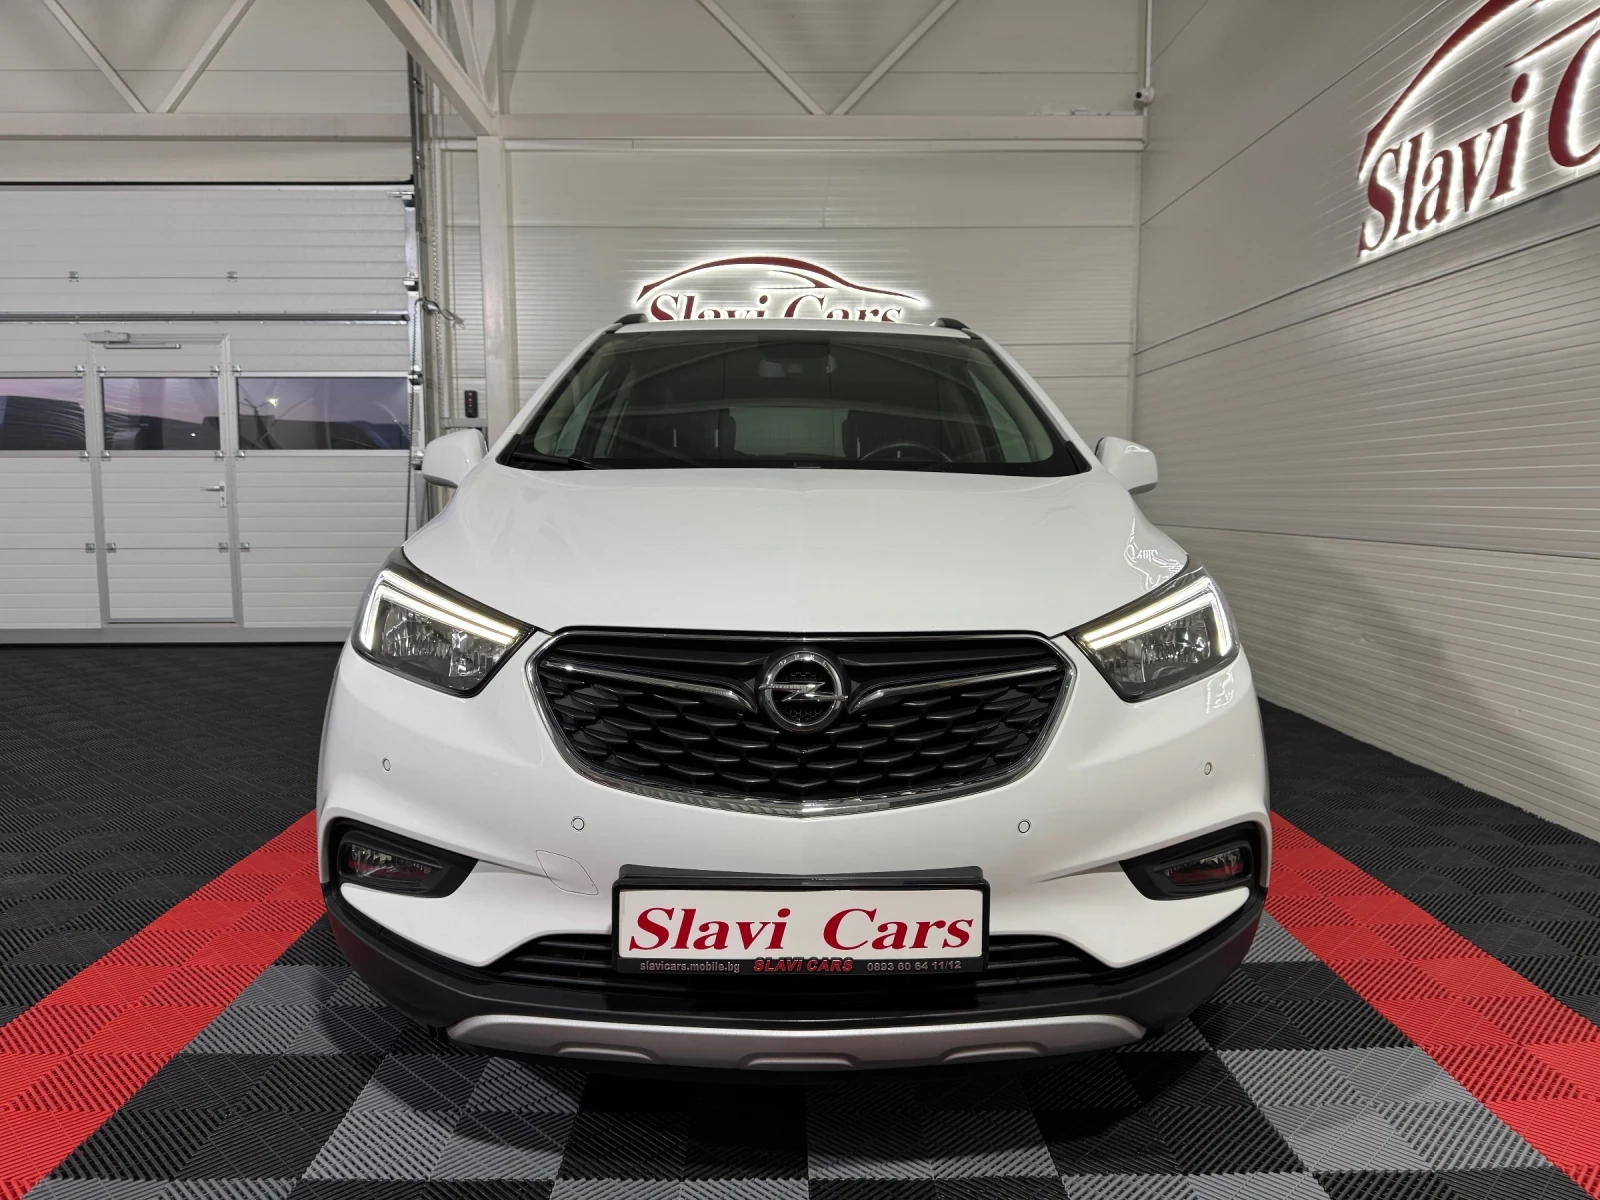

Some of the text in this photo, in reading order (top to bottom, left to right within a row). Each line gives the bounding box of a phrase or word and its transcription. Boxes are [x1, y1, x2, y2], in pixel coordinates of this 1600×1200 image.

[1358, 73, 1532, 257] Slavi
[650, 293, 769, 321] Sli
[628, 907, 974, 951] Slavi Cars
[640, 960, 740, 974] slavicars.mobile.bg
[753, 959, 854, 972] SLAVI CARS
[866, 960, 962, 972] 0893 60 64 11/12
